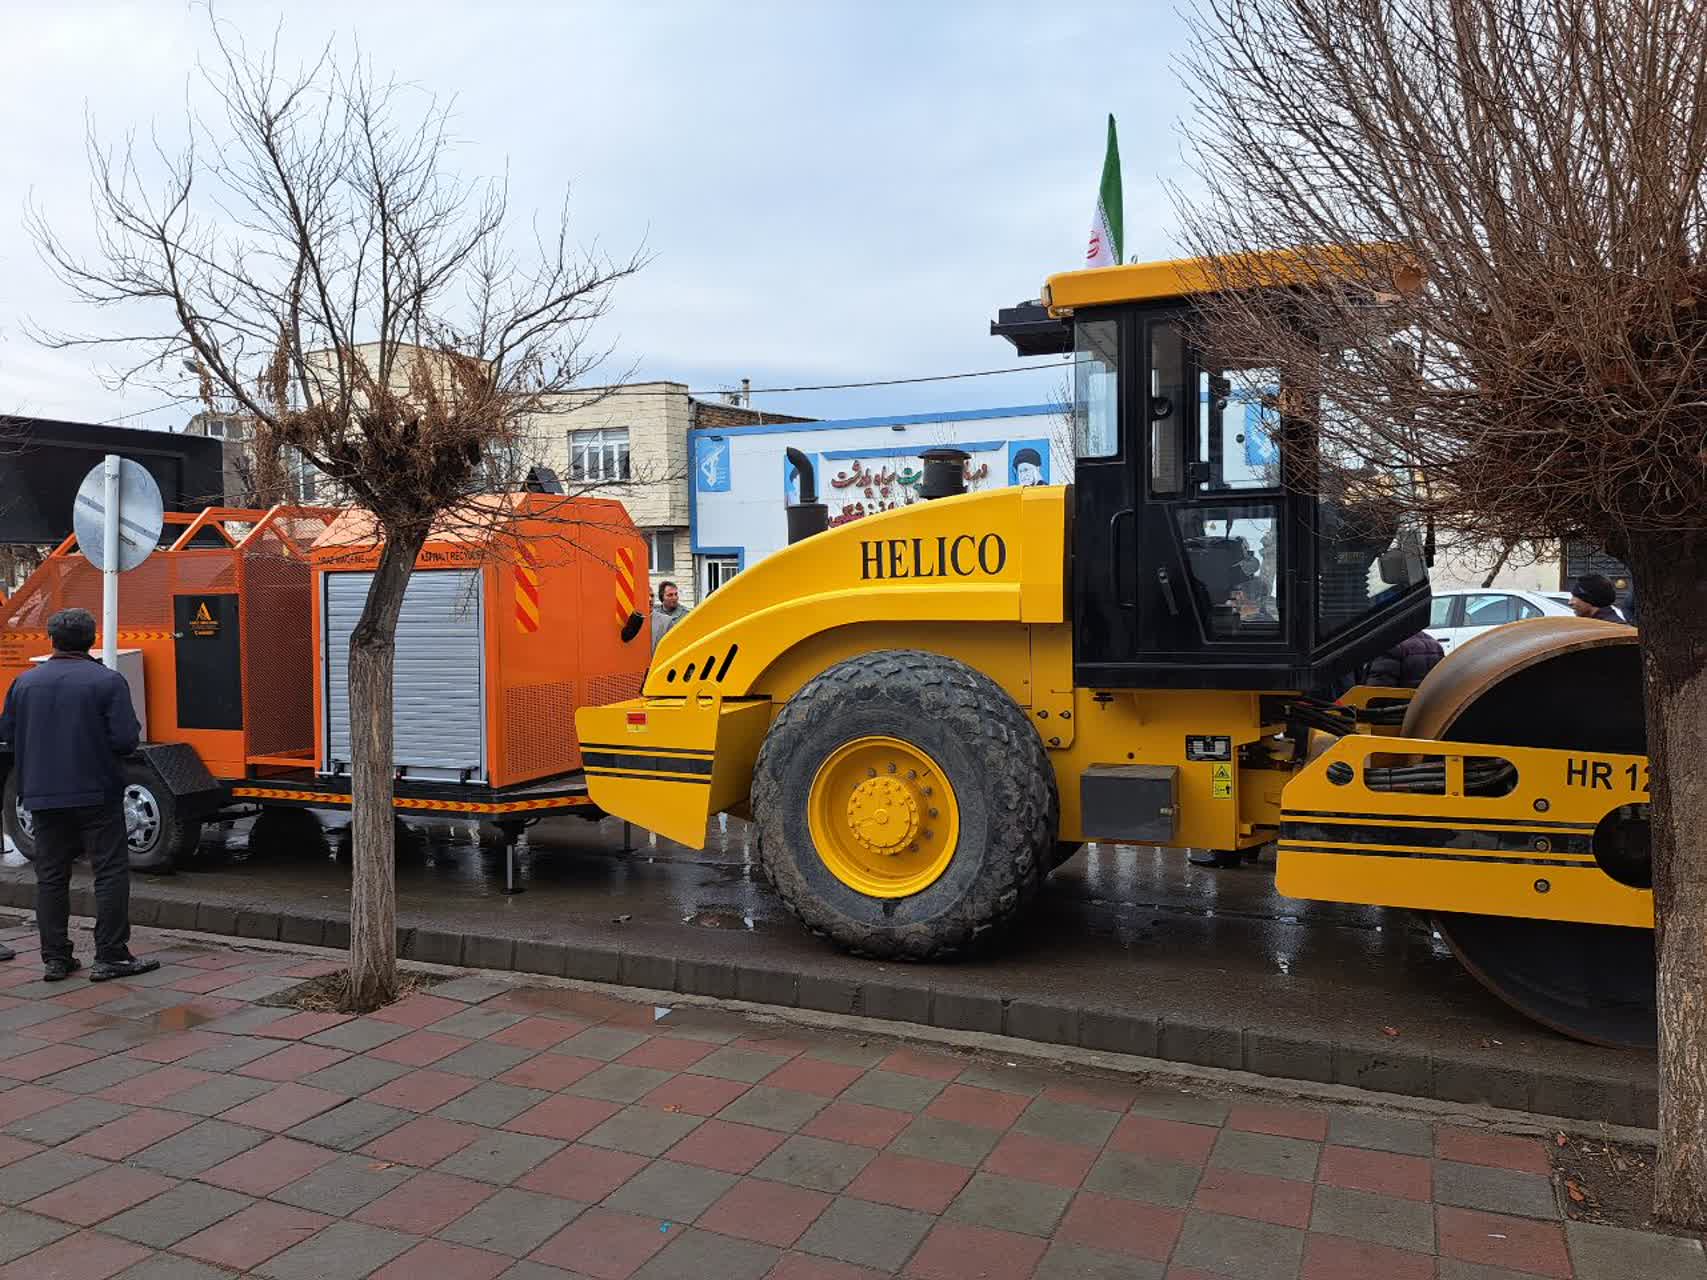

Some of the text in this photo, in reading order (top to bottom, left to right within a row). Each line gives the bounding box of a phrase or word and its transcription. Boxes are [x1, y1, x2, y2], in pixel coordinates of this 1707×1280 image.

[420, 551, 450, 562] ASPHALT
[860, 533, 1007, 580] HELICO
[1566, 758, 1613, 790] HR
